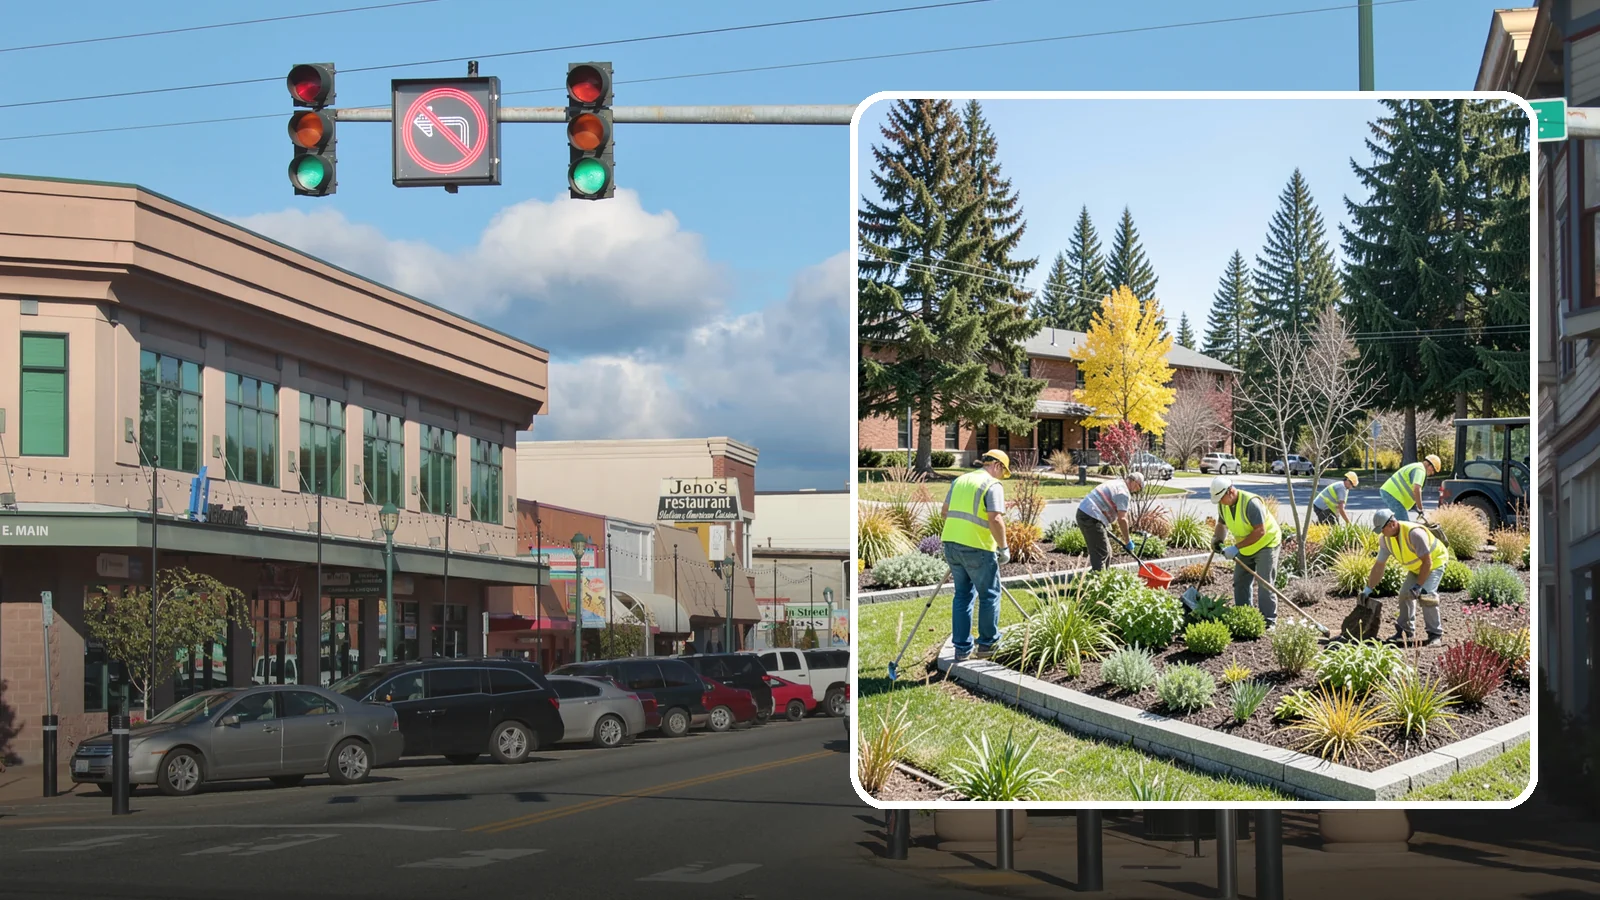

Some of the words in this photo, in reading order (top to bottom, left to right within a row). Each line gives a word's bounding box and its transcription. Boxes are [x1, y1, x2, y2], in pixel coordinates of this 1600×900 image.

[670, 480, 727, 494] Jeno's
[665, 497, 730, 508] restaurant
[659, 510, 681, 519] Italian
[686, 510, 714, 519] American
[715, 510, 737, 519] Cuisine
[2, 525, 13, 536] E.
[15, 525, 49, 536] MAIN
[797, 608, 828, 616] Street
[790, 619, 823, 627] lass
